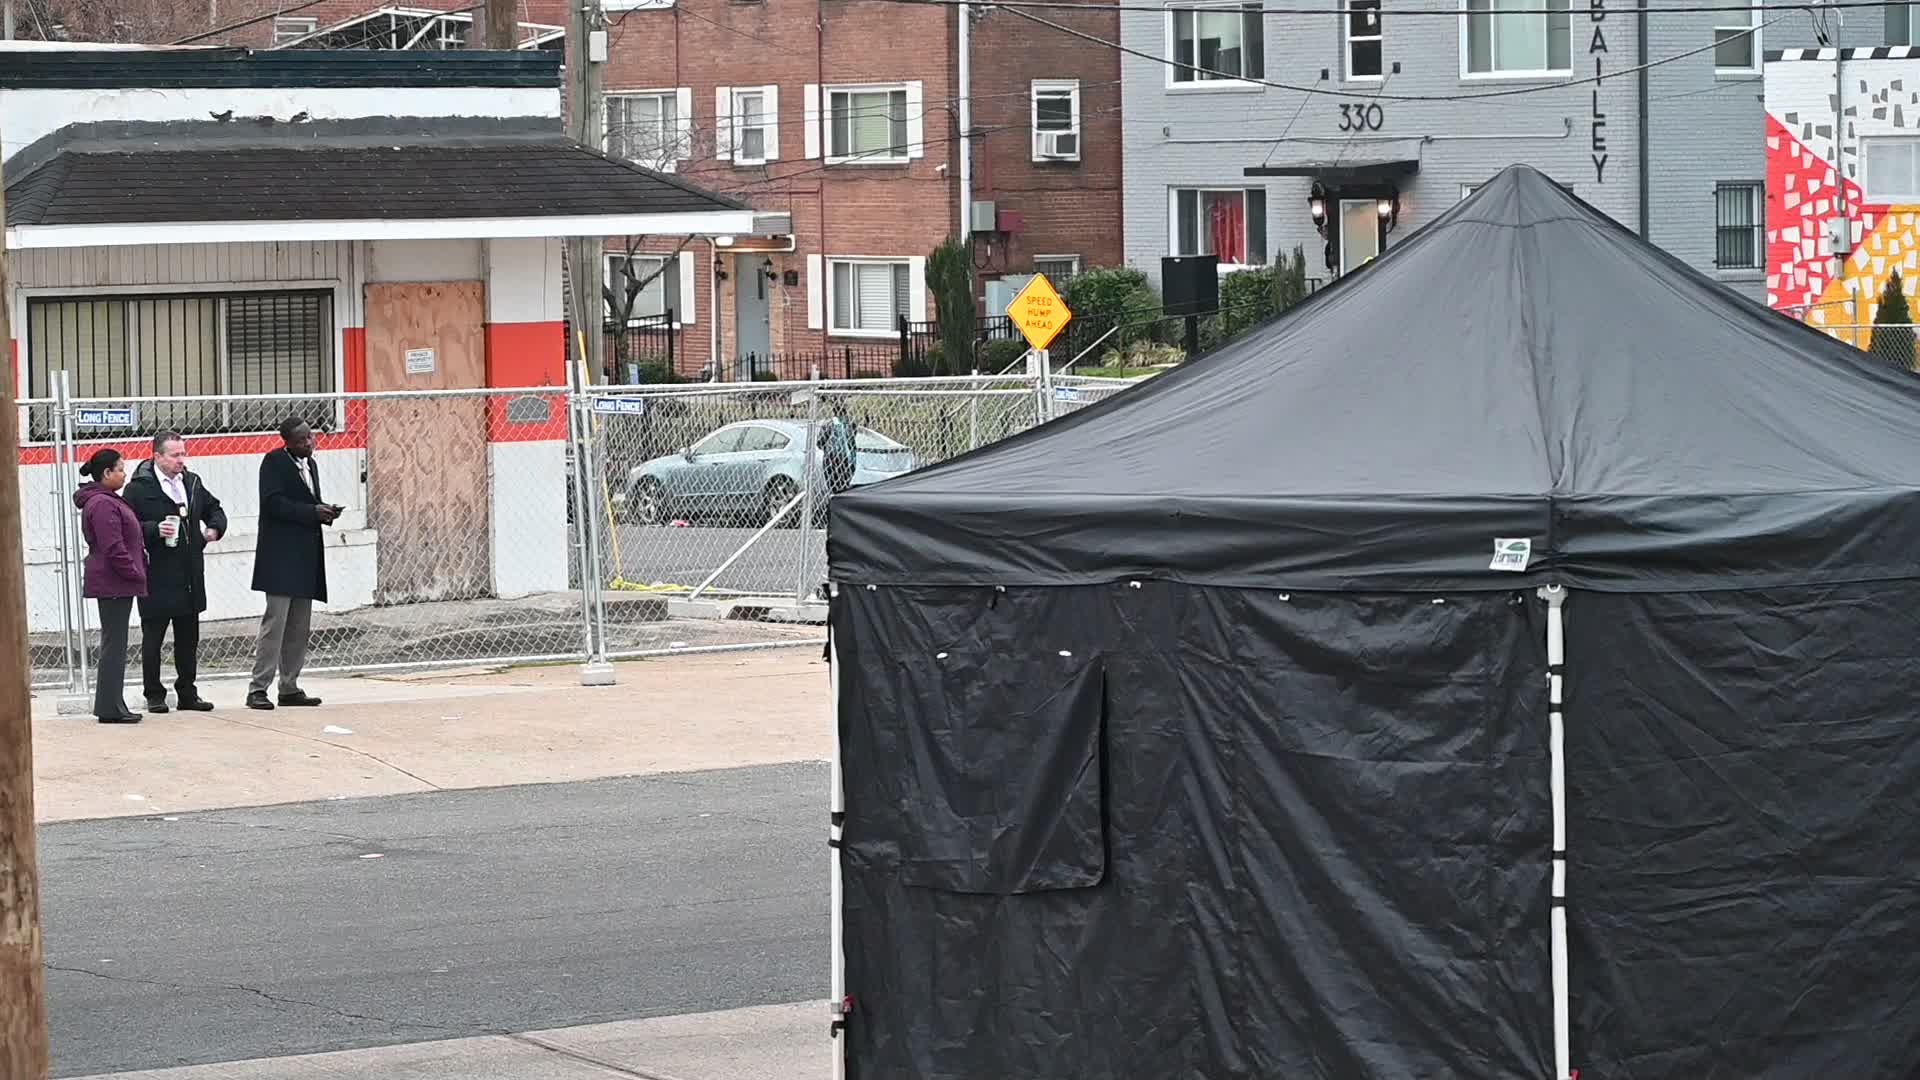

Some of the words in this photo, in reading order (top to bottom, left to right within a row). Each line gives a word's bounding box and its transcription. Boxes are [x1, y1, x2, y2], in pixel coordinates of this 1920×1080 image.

[1590, 0, 1608, 183] BAILEY
[1338, 103, 1384, 131] 330
[1026, 295, 1052, 306] SPEED
[1027, 308, 1051, 317] HUMP
[1026, 319, 1052, 329] AHEAD
[79, 411, 101, 423] LONG
[103, 411, 129, 423] FENCE
